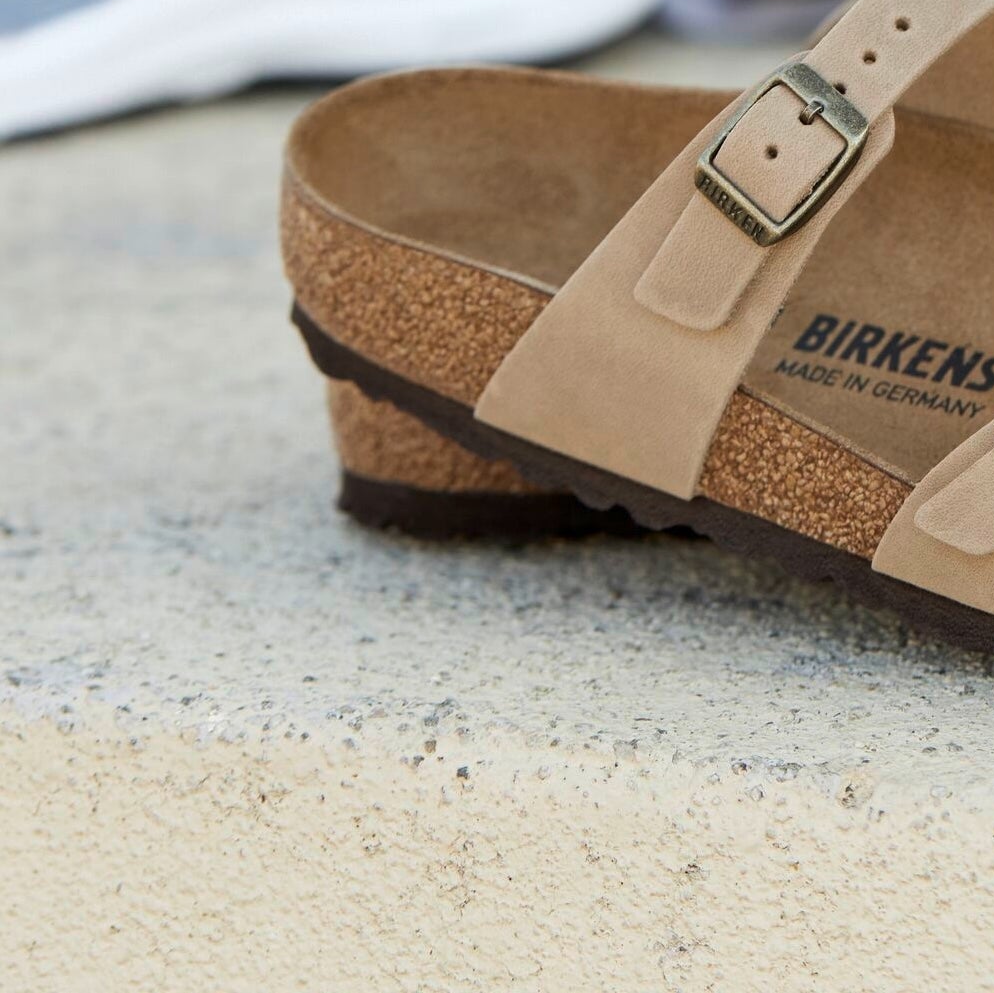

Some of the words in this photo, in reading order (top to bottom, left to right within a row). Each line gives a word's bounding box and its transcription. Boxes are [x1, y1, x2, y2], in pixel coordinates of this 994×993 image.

[698, 175, 765, 240] BIRKEN
[774, 358, 843, 386] MADE
[843, 372, 870, 393] IN
[871, 380, 987, 419] GERMANY
